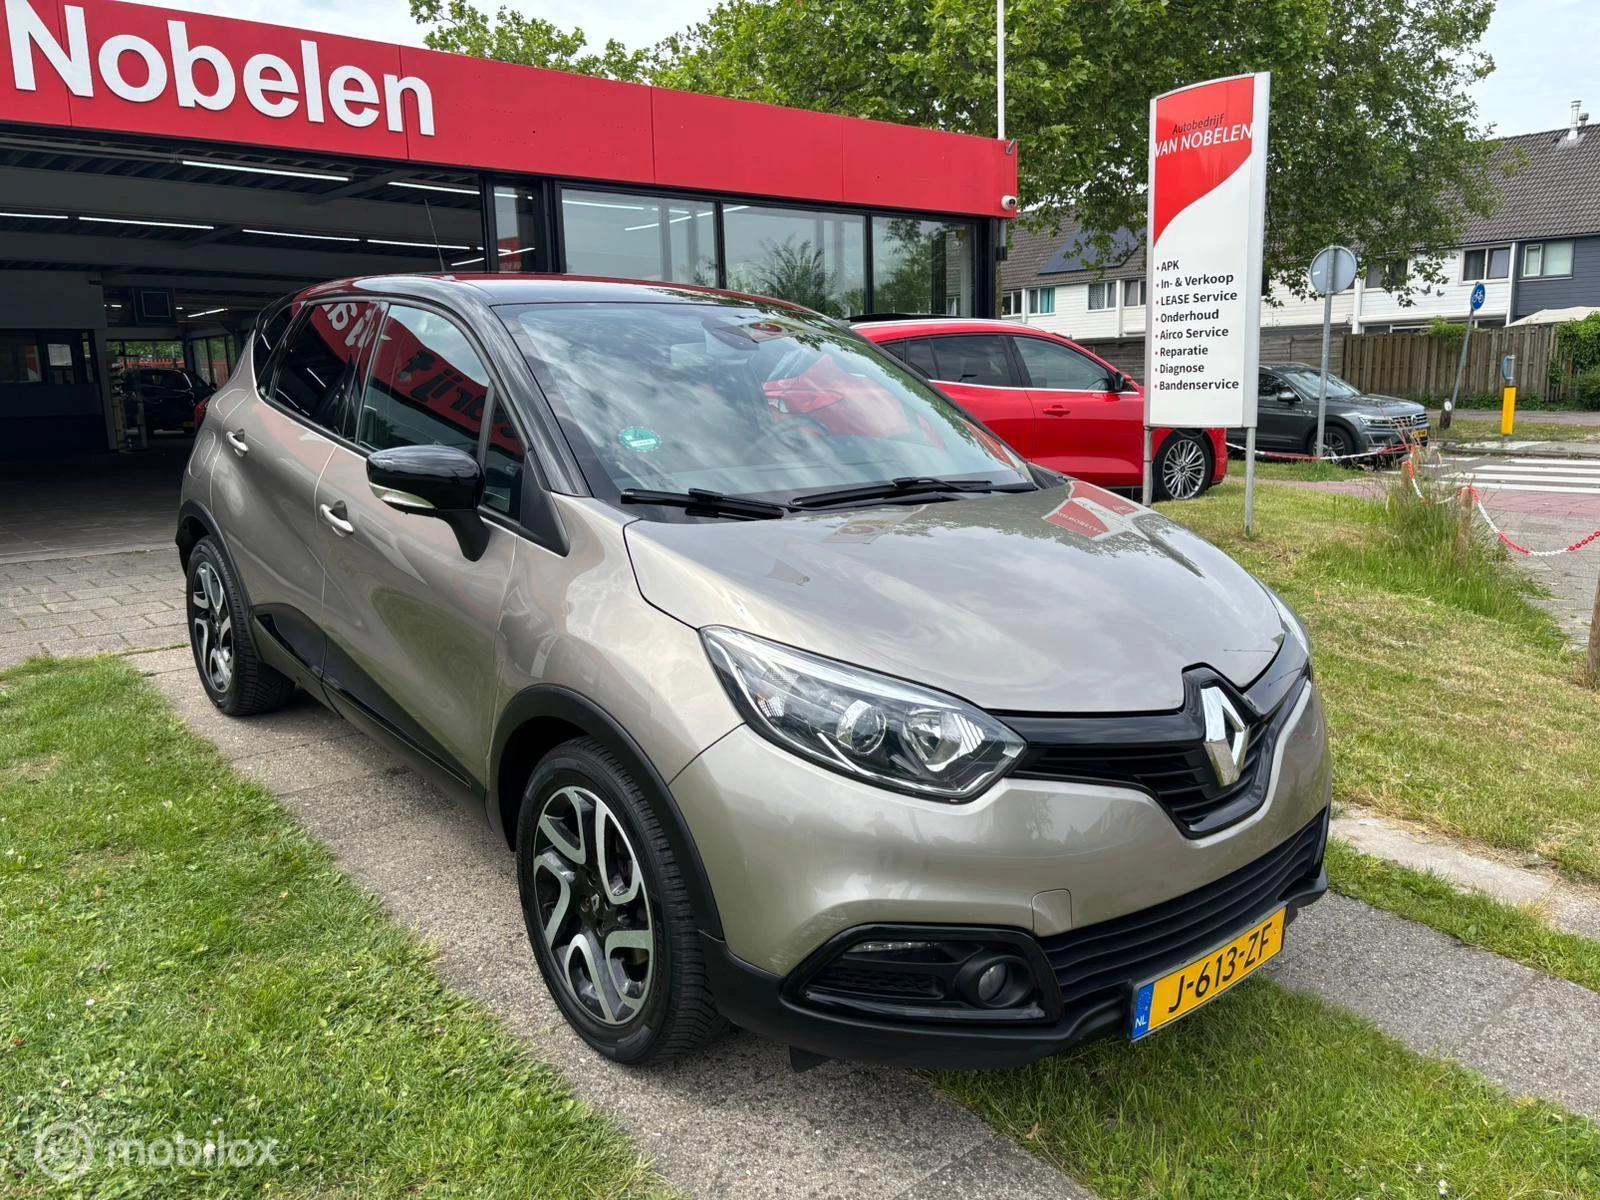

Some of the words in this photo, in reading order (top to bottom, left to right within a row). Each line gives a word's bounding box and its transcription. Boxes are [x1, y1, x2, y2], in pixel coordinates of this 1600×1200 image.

[4, 0, 435, 136] Nobelen
[1172, 113, 1225, 135] Autobedrijf
[1154, 137, 1178, 158] VAN
[1180, 122, 1254, 151] NOBELEN
[1161, 260, 1180, 272] APK
[1175, 277, 1183, 288] &
[1184, 274, 1234, 286] Verkoop
[1161, 294, 1190, 306] LEASE
[1193, 290, 1238, 303] Service
[1160, 309, 1220, 323] Onderhoud
[1160, 330, 1183, 340] Airco
[1185, 327, 1229, 339] Service
[1160, 345, 1209, 358] Reparatie
[1159, 363, 1205, 376] Diagnose
[1159, 379, 1239, 391] Bandenservice
[1168, 922, 1273, 1013] J-613-ZF
[1135, 1015, 1147, 1029] NL
